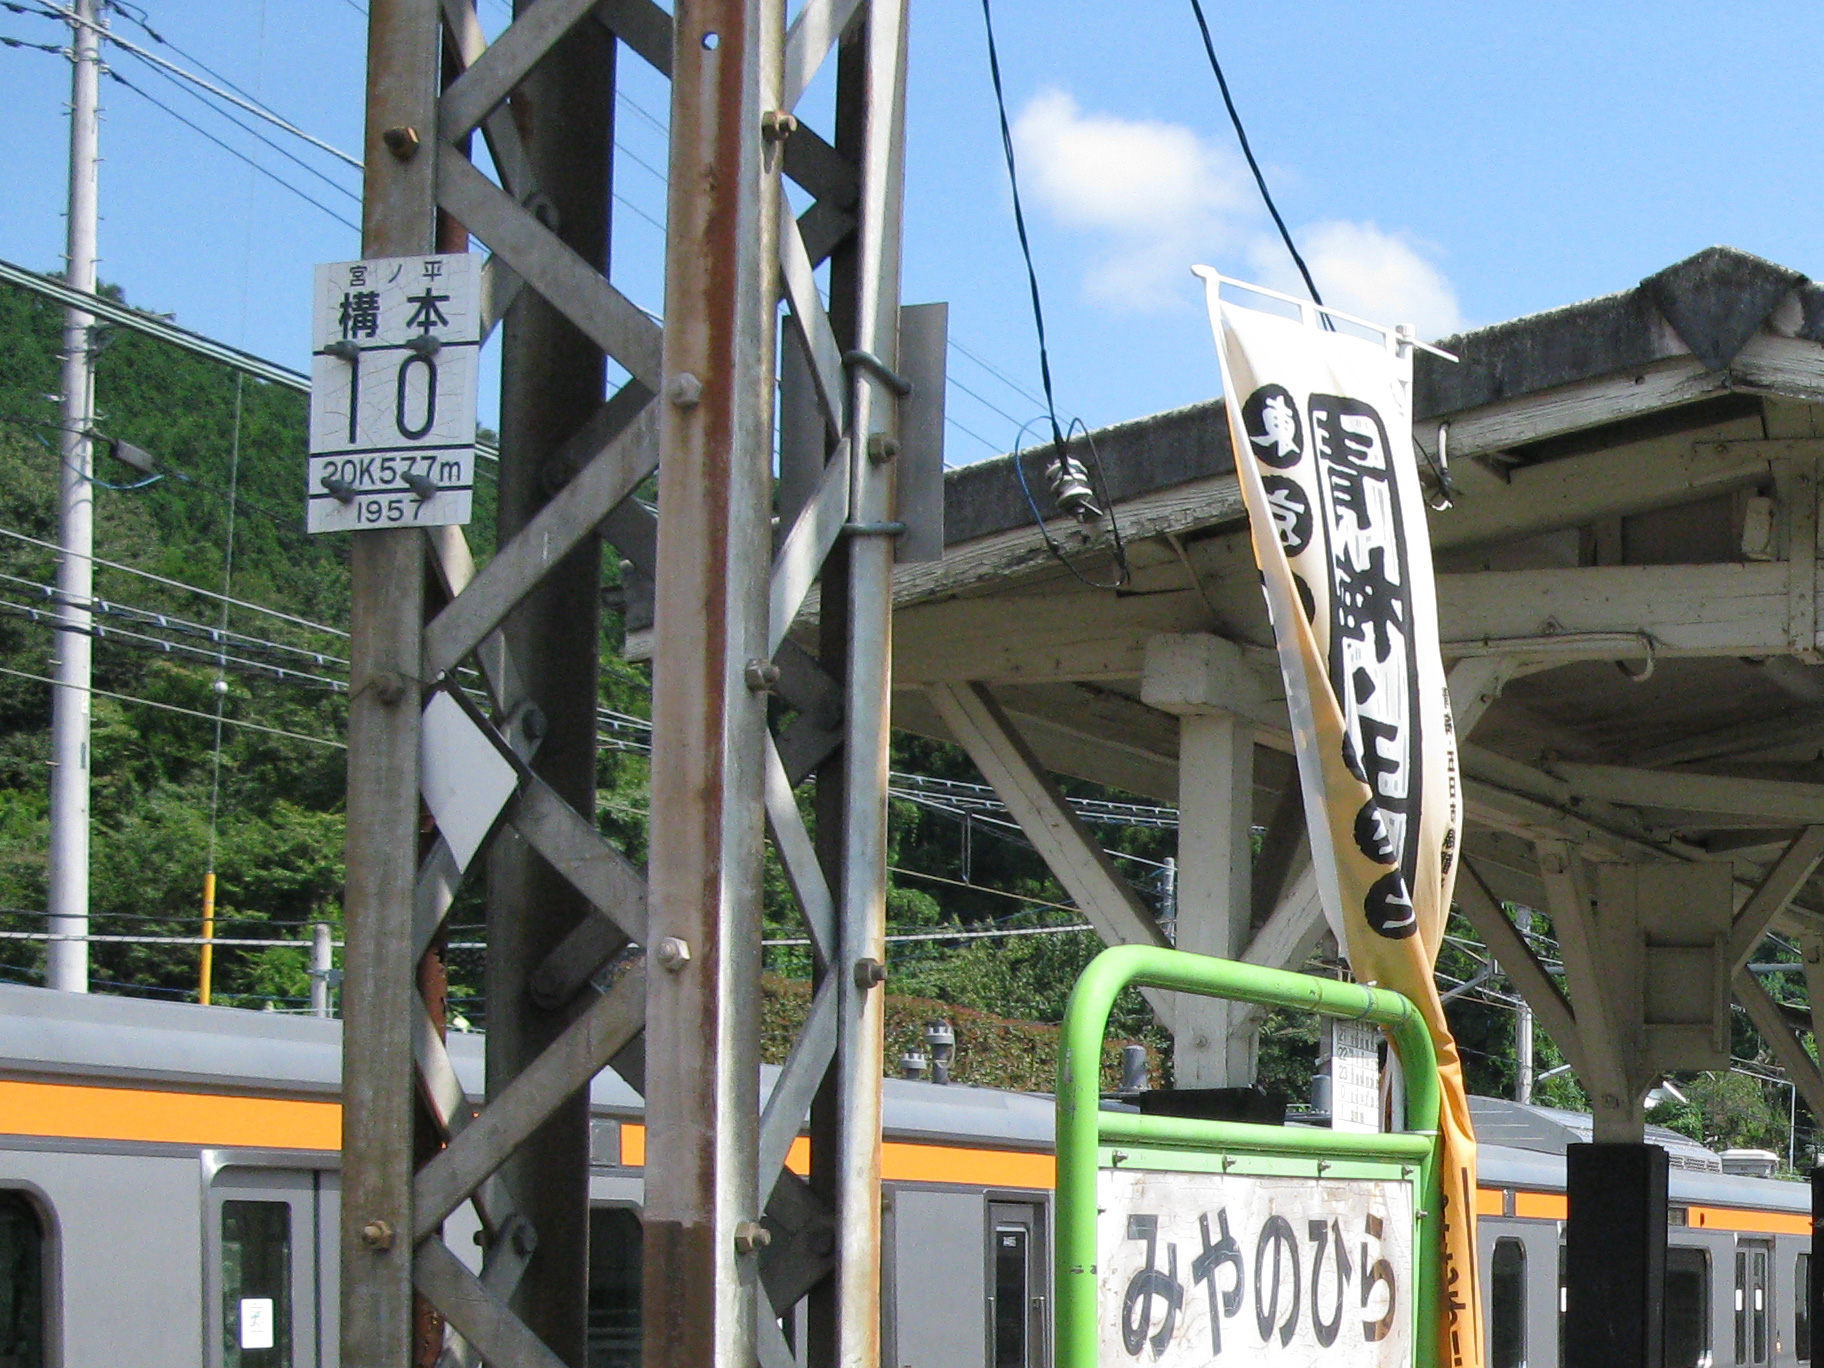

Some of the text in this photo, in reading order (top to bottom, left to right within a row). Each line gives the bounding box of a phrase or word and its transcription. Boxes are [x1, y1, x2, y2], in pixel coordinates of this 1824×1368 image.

[349, 260, 443, 287] 宮ノ平
[338, 287, 450, 339] 構本
[348, 353, 439, 444] 10
[356, 499, 425, 524] 1957
[1121, 1206, 1396, 1363] みやのひら
